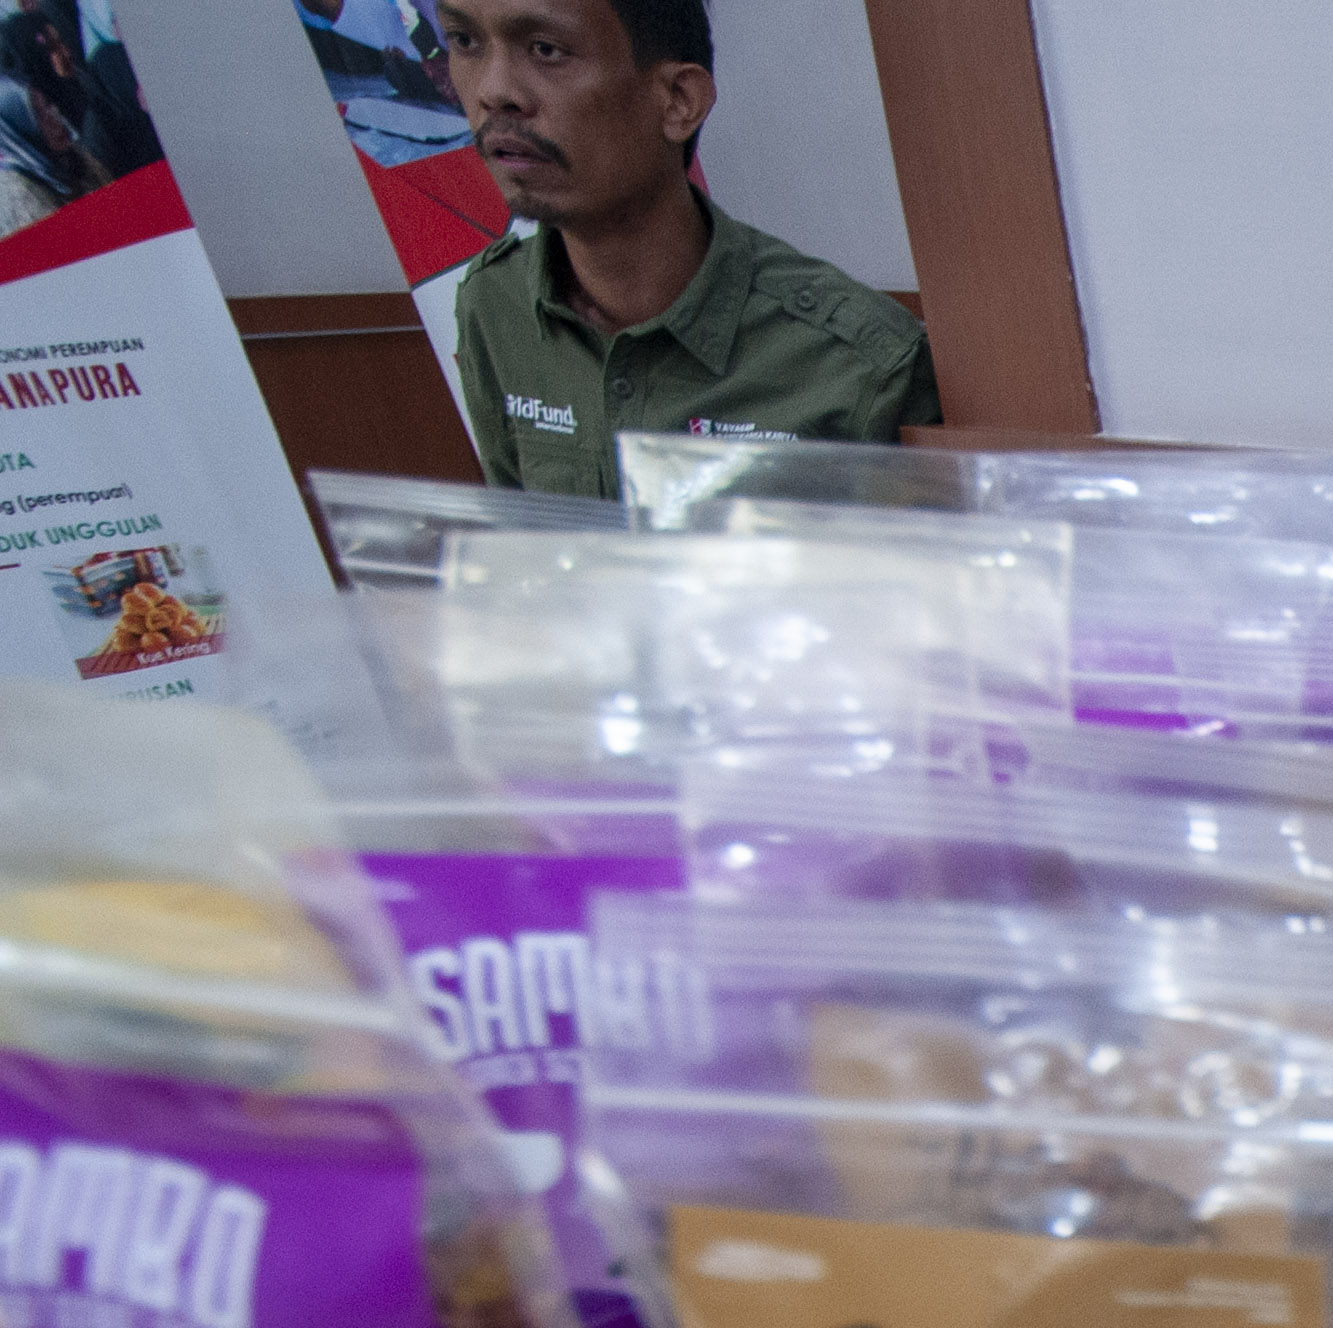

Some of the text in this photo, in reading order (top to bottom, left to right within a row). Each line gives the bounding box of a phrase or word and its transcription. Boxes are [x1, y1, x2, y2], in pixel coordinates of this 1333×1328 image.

[0, 338, 145, 363] ONOMI PEREMPUAN
[0, 362, 142, 410] ANAPURA
[0, 513, 163, 552] DUK UNGGULAN
